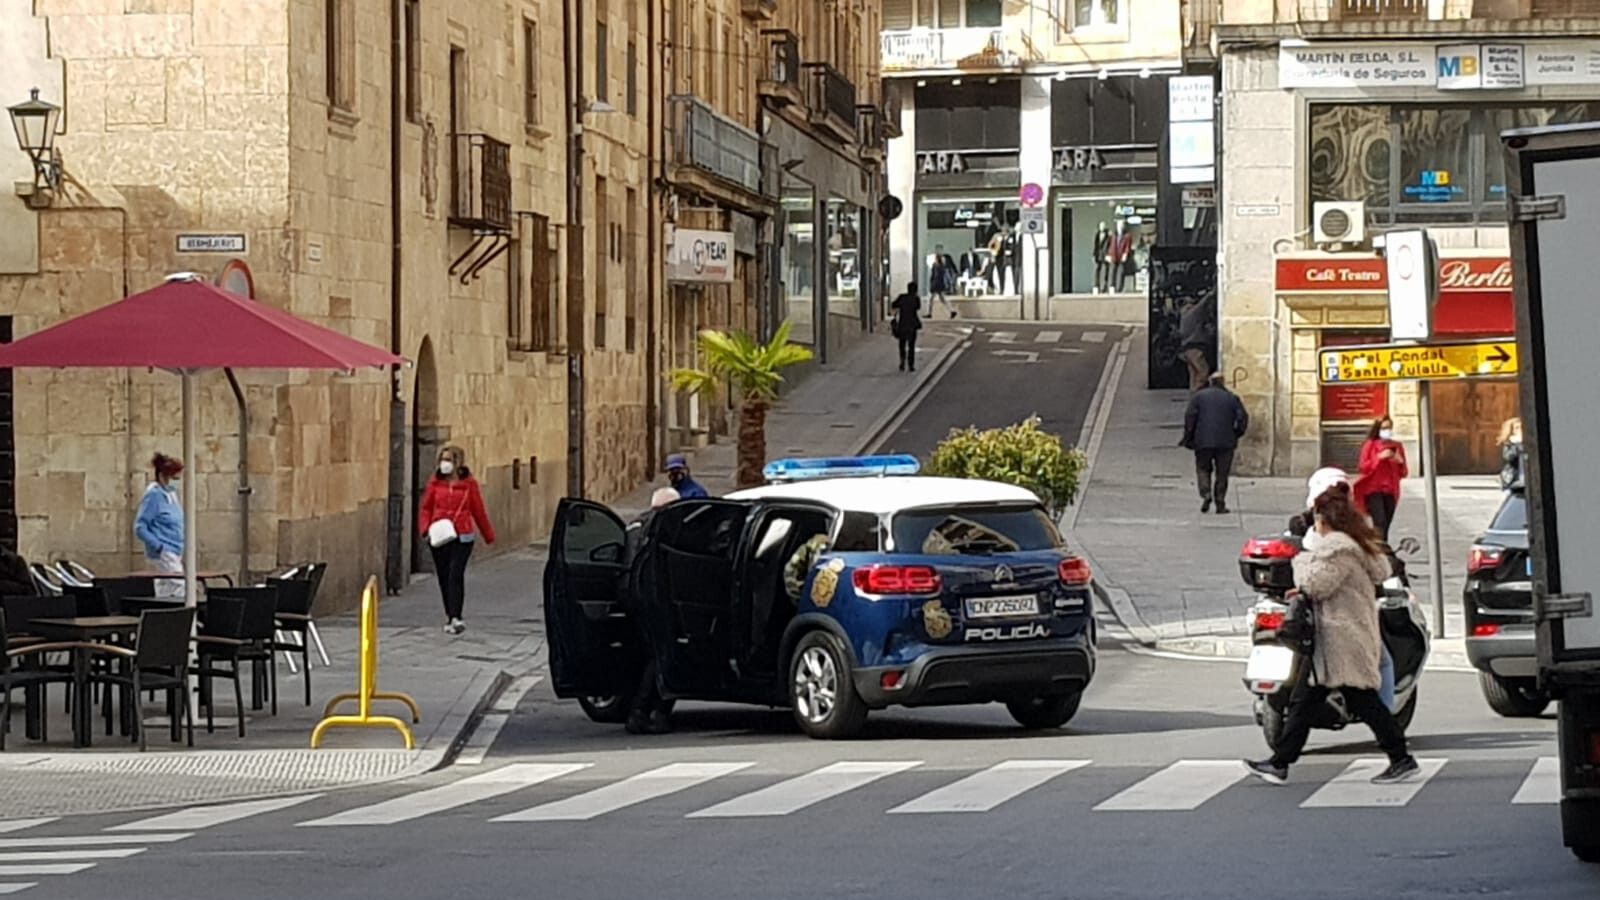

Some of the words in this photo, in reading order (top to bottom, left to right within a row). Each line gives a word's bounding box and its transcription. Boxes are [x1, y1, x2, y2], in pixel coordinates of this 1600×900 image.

[1295, 51, 1344, 64] MARTÍN
[1353, 67, 1369, 79] de
[1374, 67, 1427, 80] Seguros
[1438, 56, 1477, 78] MB
[922, 152, 963, 173] ARA
[1059, 149, 1100, 170] ARA
[1422, 171, 1449, 185] MB
[1338, 267, 1380, 282] Teatro
[1343, 366, 1388, 379] Santa
[1394, 361, 1449, 376] ulalia
[964, 621, 1047, 641] POLICÍA
